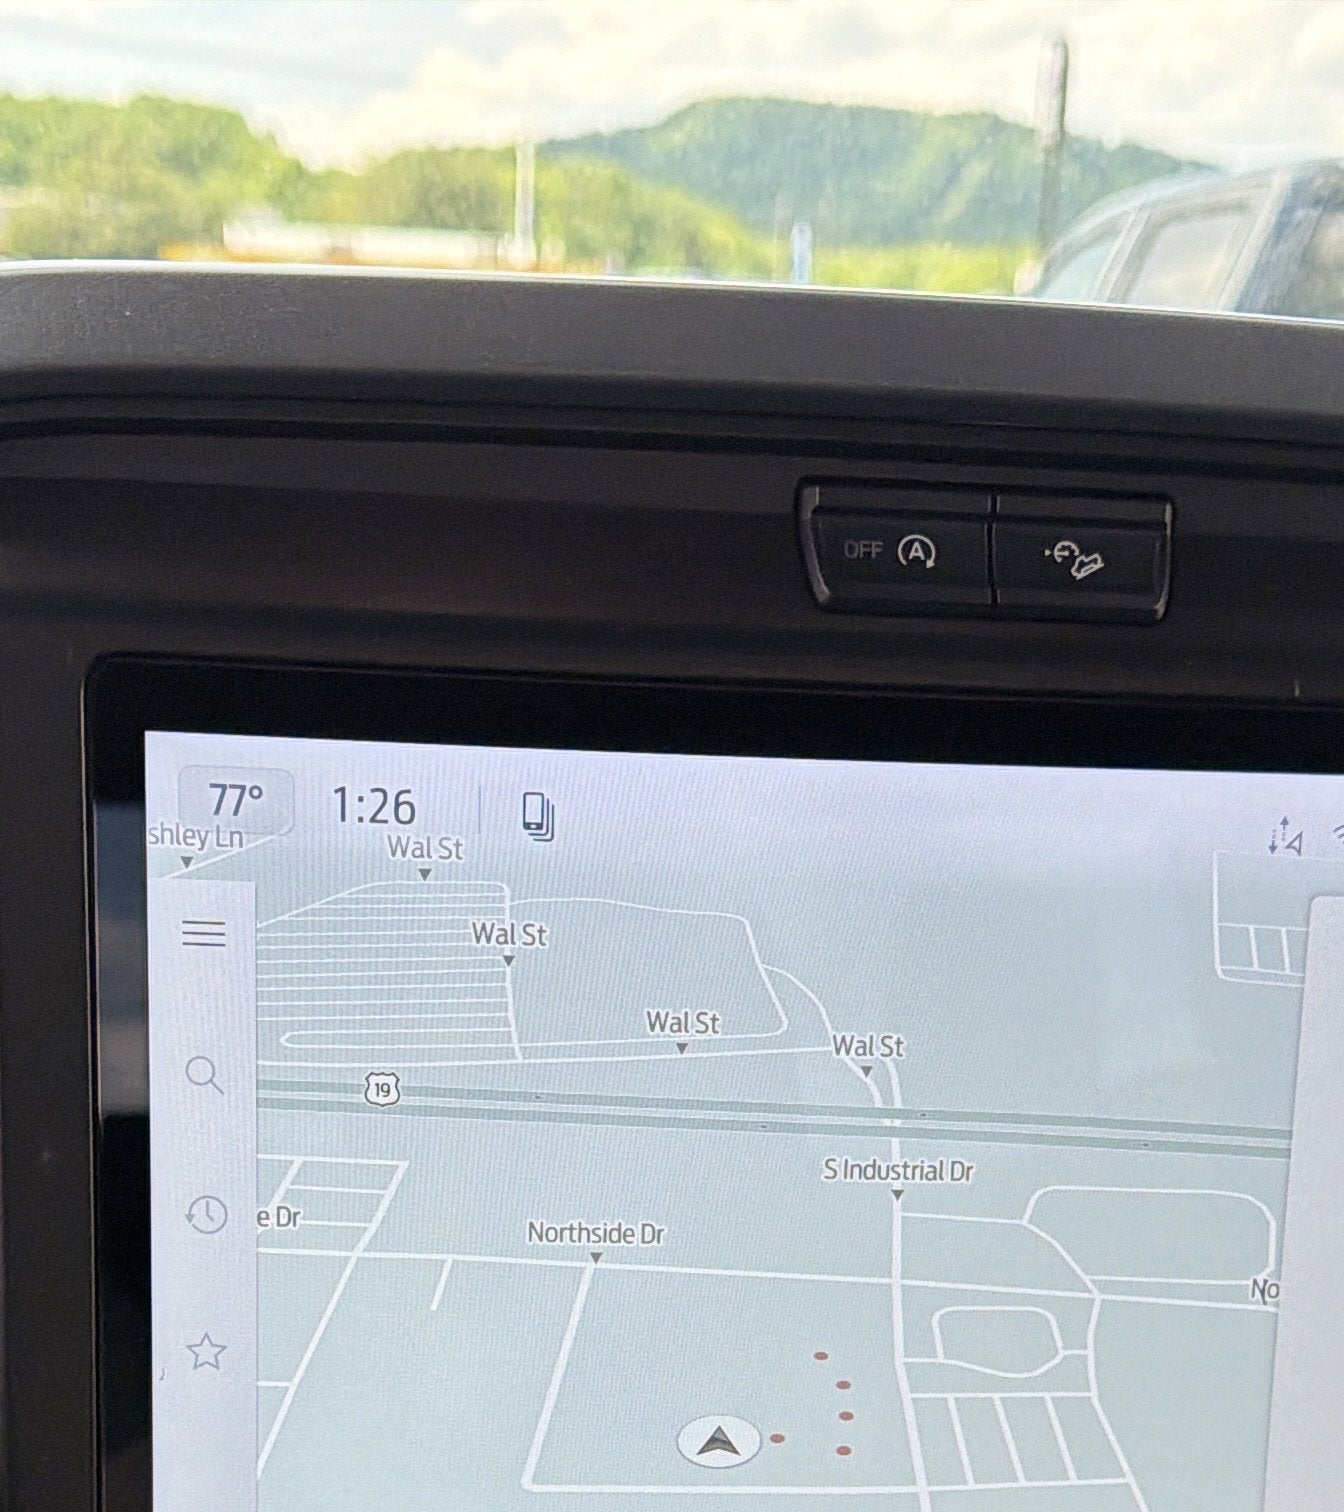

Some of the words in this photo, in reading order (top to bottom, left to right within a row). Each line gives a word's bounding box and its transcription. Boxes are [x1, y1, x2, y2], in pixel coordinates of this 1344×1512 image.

[844, 541, 883, 559] OFF
[207, 782, 264, 818] 77°
[333, 785, 417, 825] 1:26
[148, 821, 209, 851] shley
[216, 824, 244, 848] Ln
[388, 836, 433, 860] Wal
[437, 838, 463, 861] St
[471, 922, 515, 946] Wal
[521, 923, 547, 947] St
[646, 1010, 690, 1034] Wal
[695, 1012, 720, 1035] St
[832, 1034, 875, 1058] Wal
[879, 1036, 904, 1060] St
[374, 1082, 391, 1099] 19
[823, 1158, 838, 1182] S
[843, 1158, 945, 1184] Industrial
[950, 1160, 975, 1184] Dr
[276, 1205, 301, 1228] Dr
[527, 1222, 635, 1246] Northside
[640, 1224, 665, 1247] Dr
